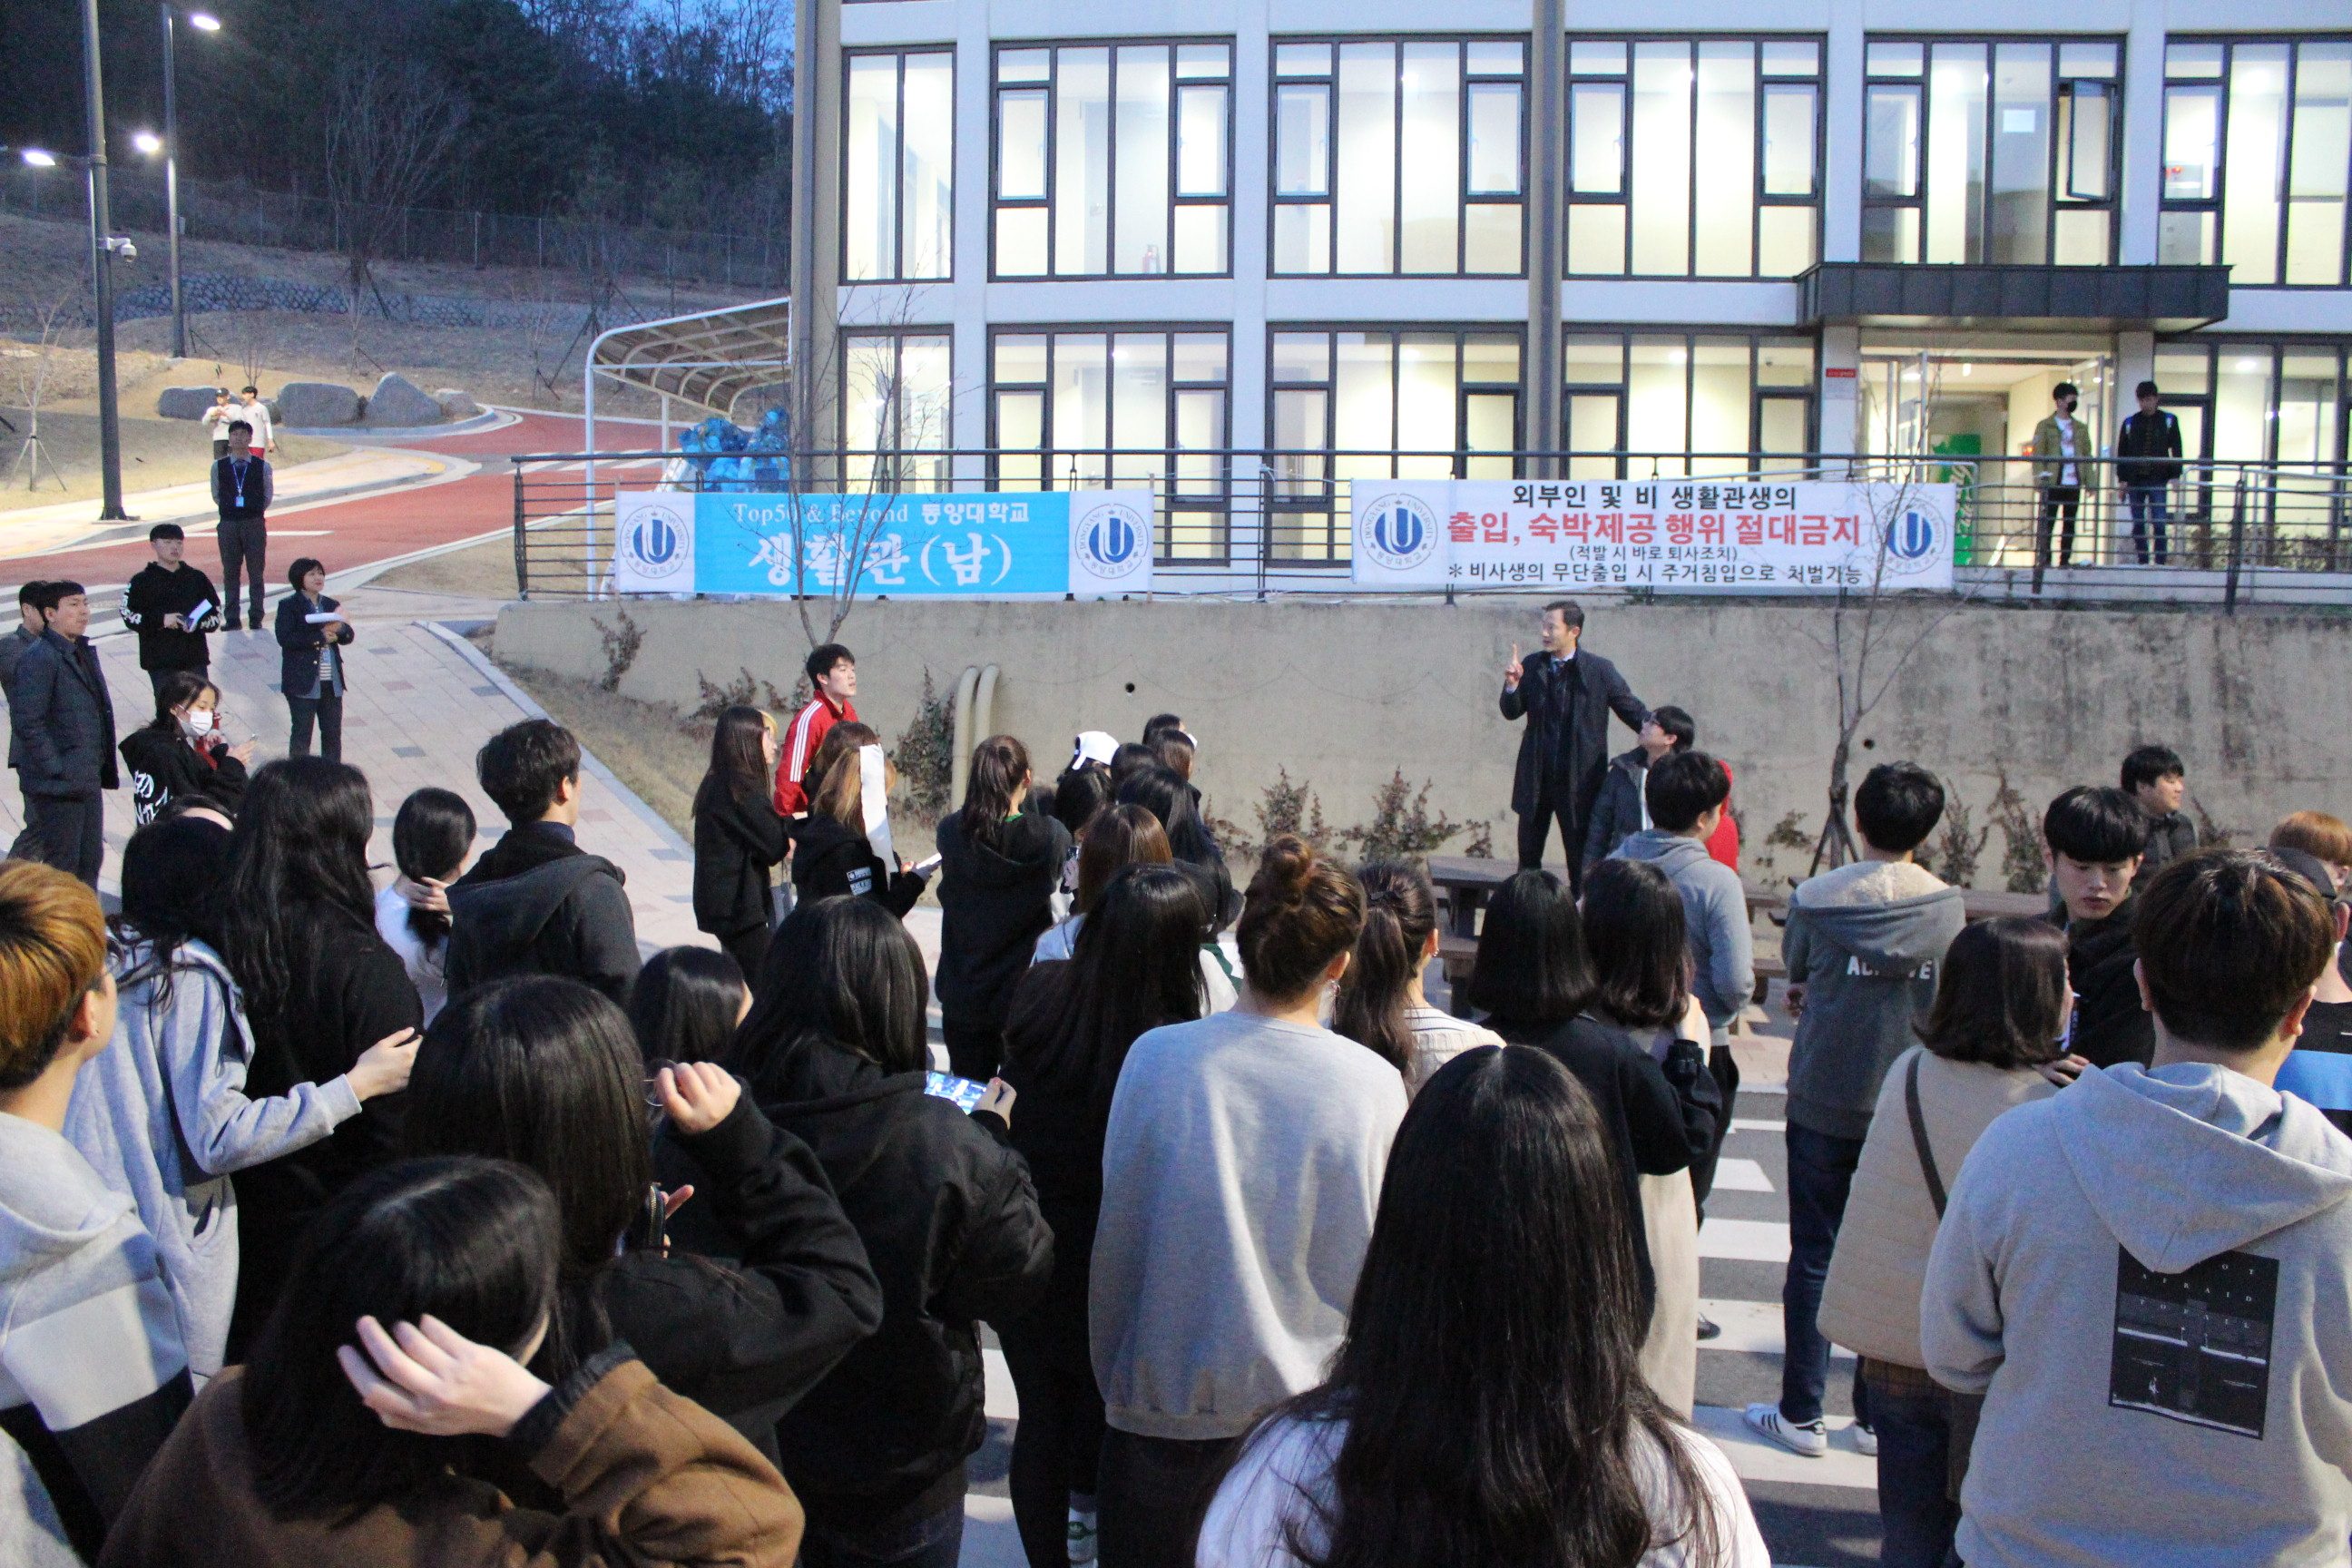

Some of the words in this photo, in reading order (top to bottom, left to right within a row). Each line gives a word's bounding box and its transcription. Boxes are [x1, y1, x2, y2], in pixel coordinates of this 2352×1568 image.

[1513, 485, 1586, 508] 외부인
[1601, 485, 1622, 509] 및
[1636, 485, 1657, 509] 비
[1671, 486, 1797, 510] 생활관생의
[807, 504, 825, 523] &
[922, 502, 1030, 525] 동양대학교
[1447, 511, 1521, 546] 출입,
[1528, 512, 1658, 544] 숙박제공
[1665, 513, 1726, 544] 행위
[1735, 514, 1860, 546] 절대금지
[1569, 544, 1608, 562] (적발
[1612, 545, 1627, 562] 시
[1633, 545, 1662, 560] 바로
[1668, 546, 1739, 562] 퇴사조치)
[1469, 562, 1544, 582] 비사생의
[1552, 563, 1627, 583] 무단출입
[1637, 564, 1653, 583] 시
[1661, 564, 1777, 583] 주거침입으로
[1788, 564, 1863, 585] 처벌가능
